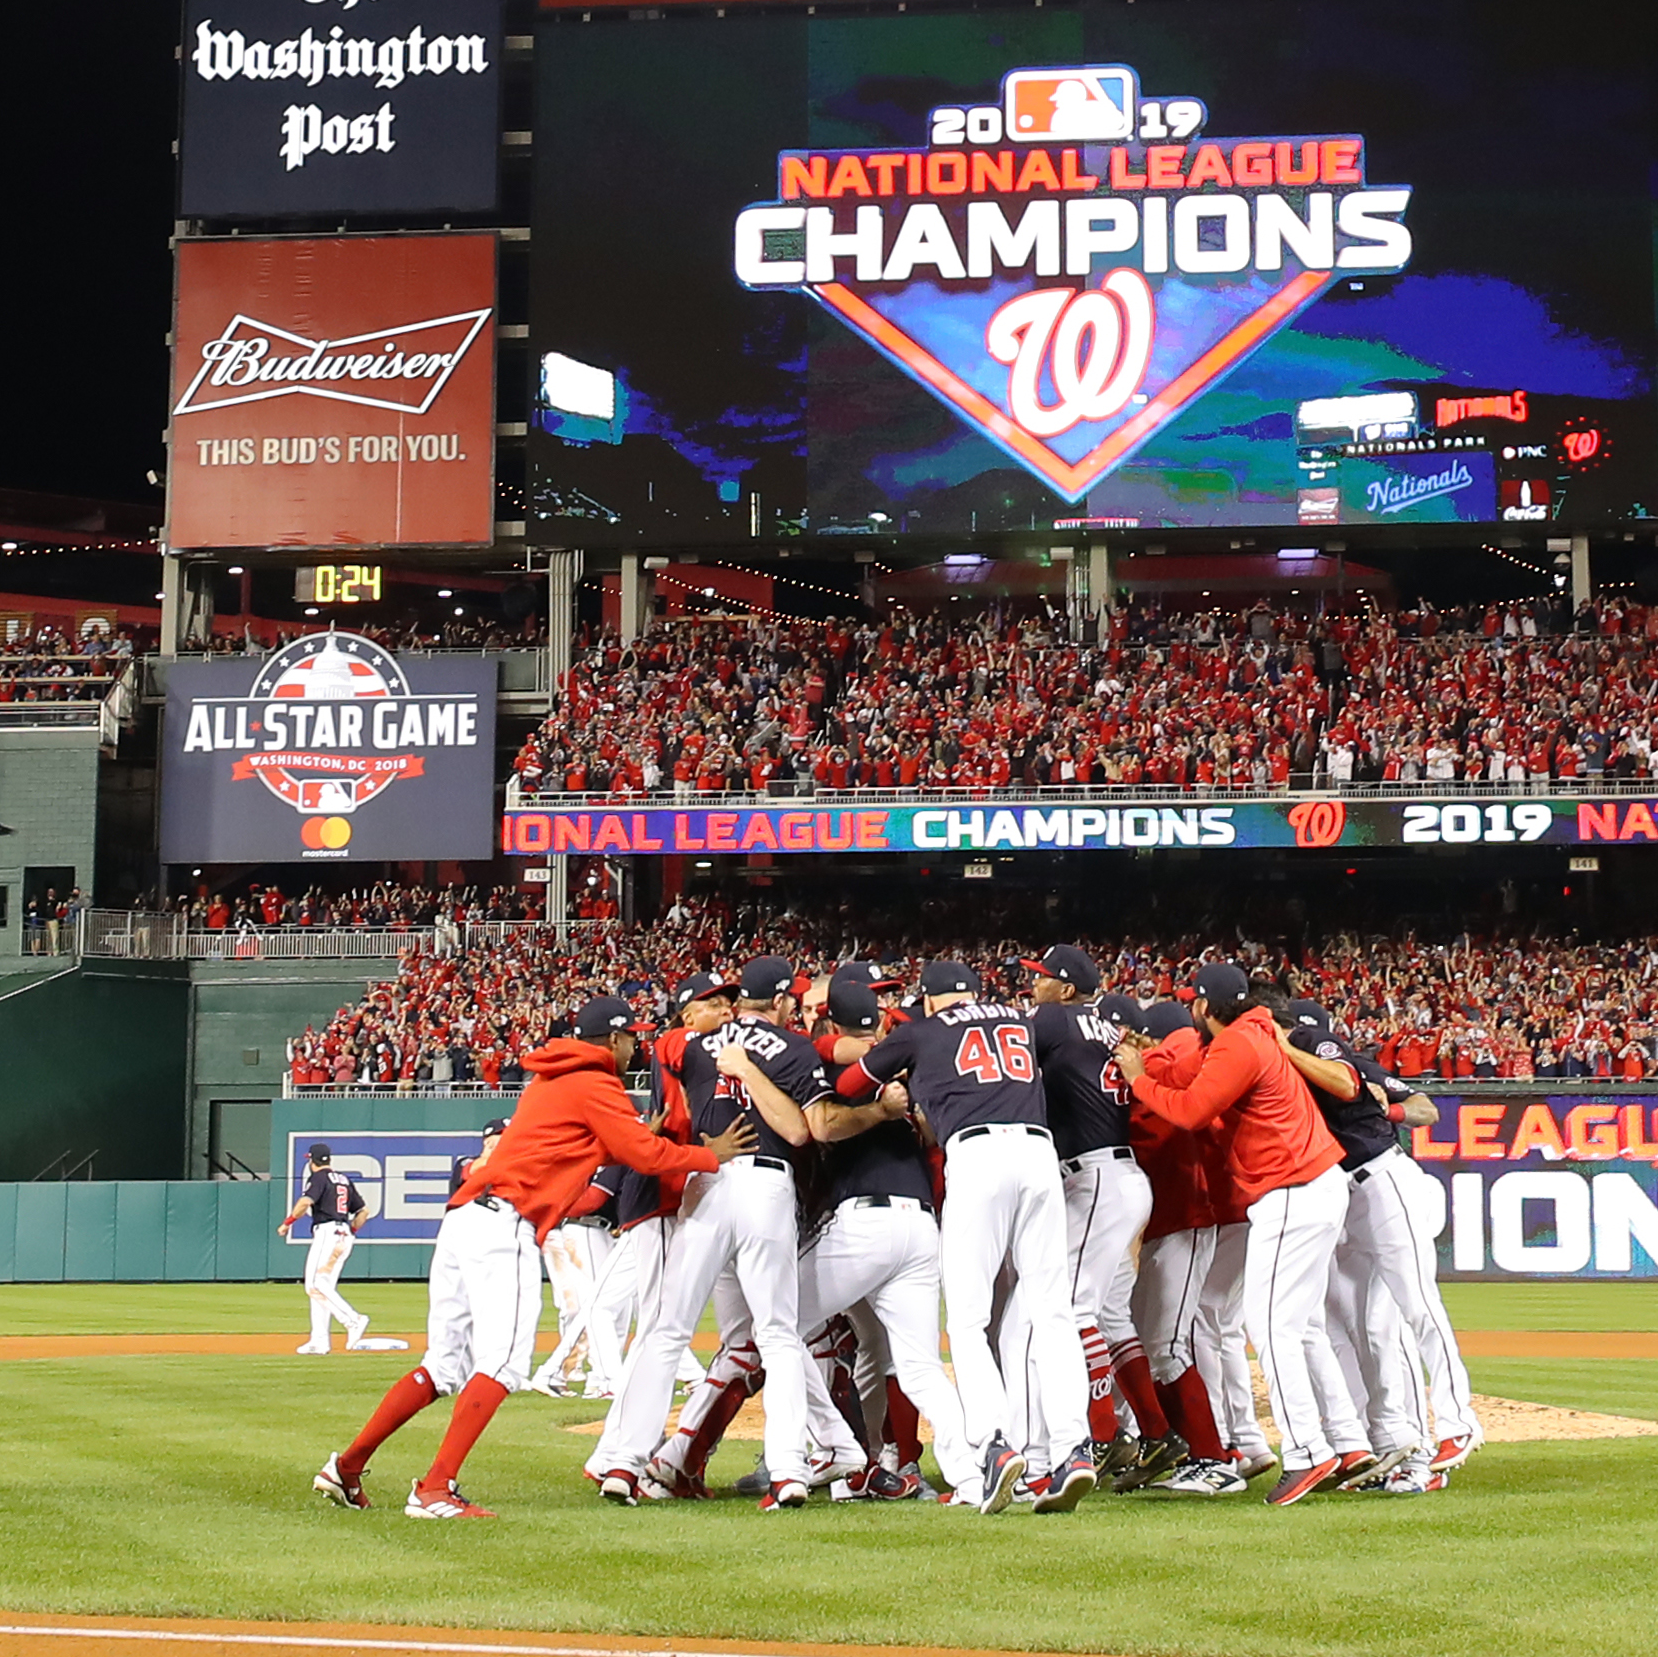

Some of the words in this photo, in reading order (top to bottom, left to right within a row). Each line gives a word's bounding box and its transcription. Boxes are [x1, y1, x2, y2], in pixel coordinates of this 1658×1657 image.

[192, 19, 489, 89] Washington
[279, 102, 396, 172] Post
[932, 108, 1002, 144] 20
[1139, 100, 1202, 138] 19
[781, 150, 1099, 200] NATIONAL
[1110, 139, 1361, 187] LEAGUE
[735, 190, 1413, 284] CHAMPIONS
[202, 338, 456, 386] Budweiser
[197, 438, 254, 466] THIS
[262, 435, 341, 464] BUD'S
[348, 435, 399, 462] FOR
[406, 434, 466, 461] YOU.
[1347, 440, 1436, 454] NATIONALS
[1443, 437, 1485, 449] PARK
[1517, 446, 1547, 458] PNC
[1366, 460, 1473, 512] Nationals
[315, 565, 381, 602] 0:24
[373, 702, 478, 749] GAME
[249, 755, 346, 771] WASHINGTON,
[348, 760, 366, 771] DC
[375, 758, 407, 771] 2018
[675, 810, 889, 849] LEAGUE
[912, 806, 1235, 848] CHAMPIONS
[1403, 802, 1551, 842] 2019
[955, 1024, 1034, 1084] 46
[301, 1154, 457, 1220] GE
